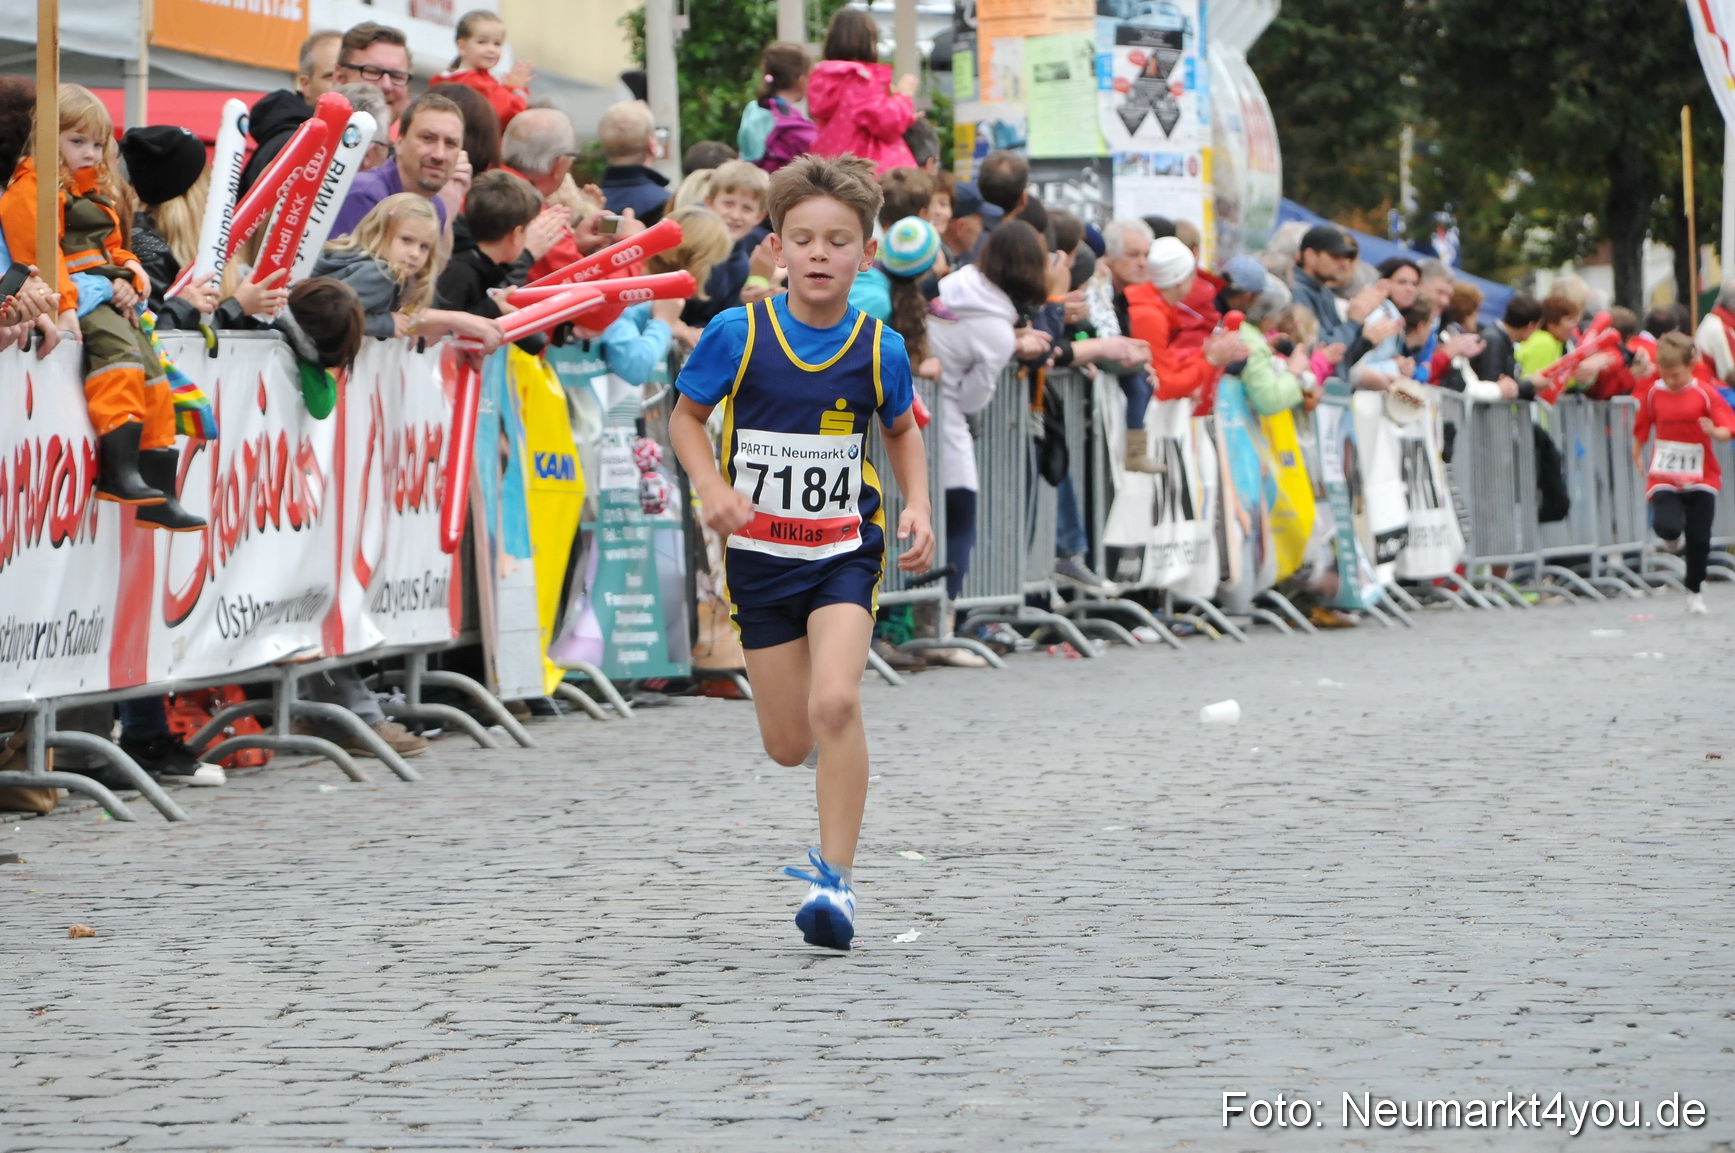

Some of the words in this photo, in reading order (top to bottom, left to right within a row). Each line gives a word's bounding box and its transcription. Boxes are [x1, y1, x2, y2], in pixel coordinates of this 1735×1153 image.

[270, 228, 294, 267] Audi
[285, 191, 308, 228] BKK
[741, 441, 778, 457] PARTL
[781, 446, 845, 460] Neumarkt
[746, 461, 851, 513] 7184
[770, 520, 824, 543] Niklas
[61, 604, 105, 657] Radio
